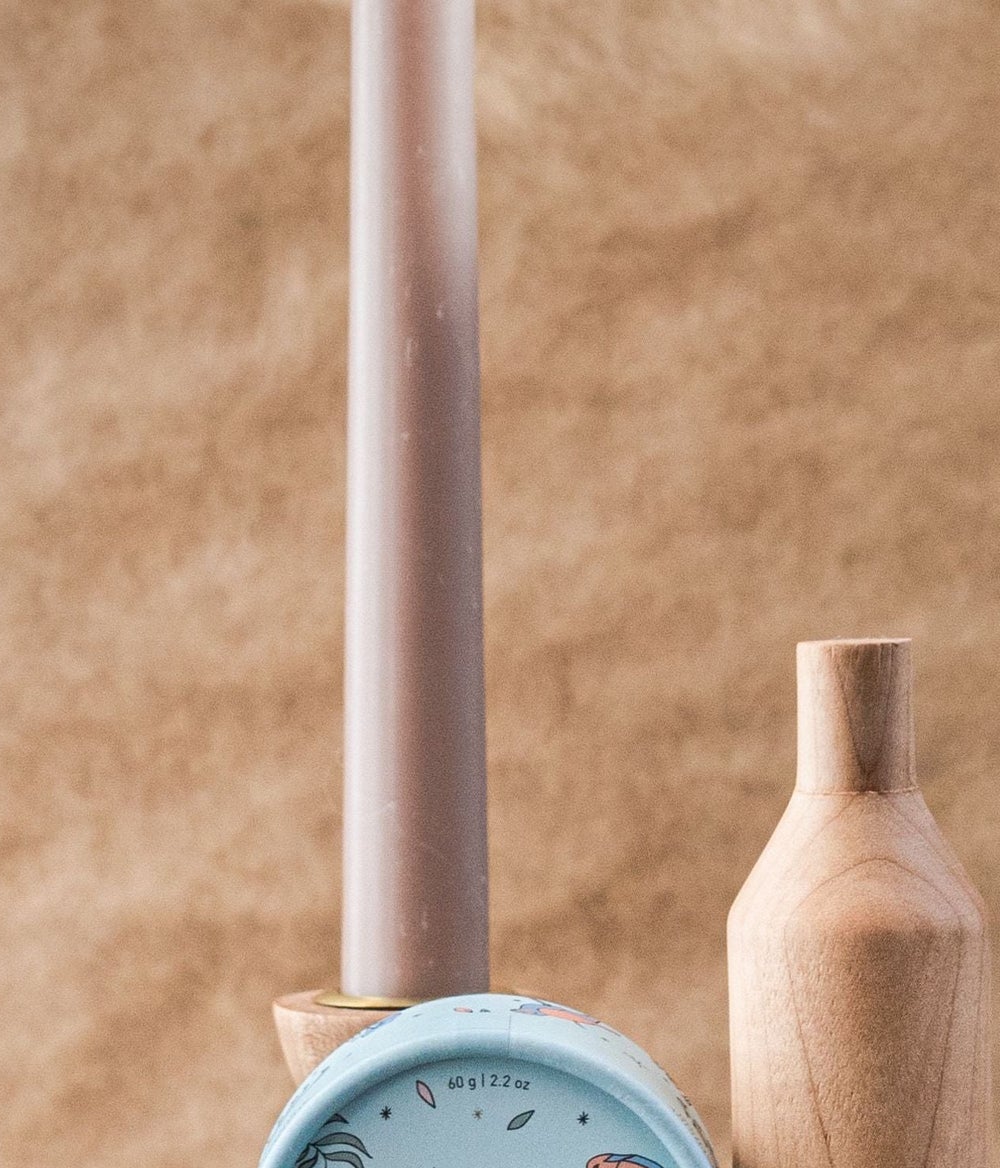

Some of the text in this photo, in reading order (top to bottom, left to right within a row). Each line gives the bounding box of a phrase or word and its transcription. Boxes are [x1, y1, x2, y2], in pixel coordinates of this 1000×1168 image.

[448, 1076, 464, 1089] 60
[468, 1078, 476, 1090] g
[490, 1074, 511, 1087] 2.2
[515, 1080, 530, 1090] oz
